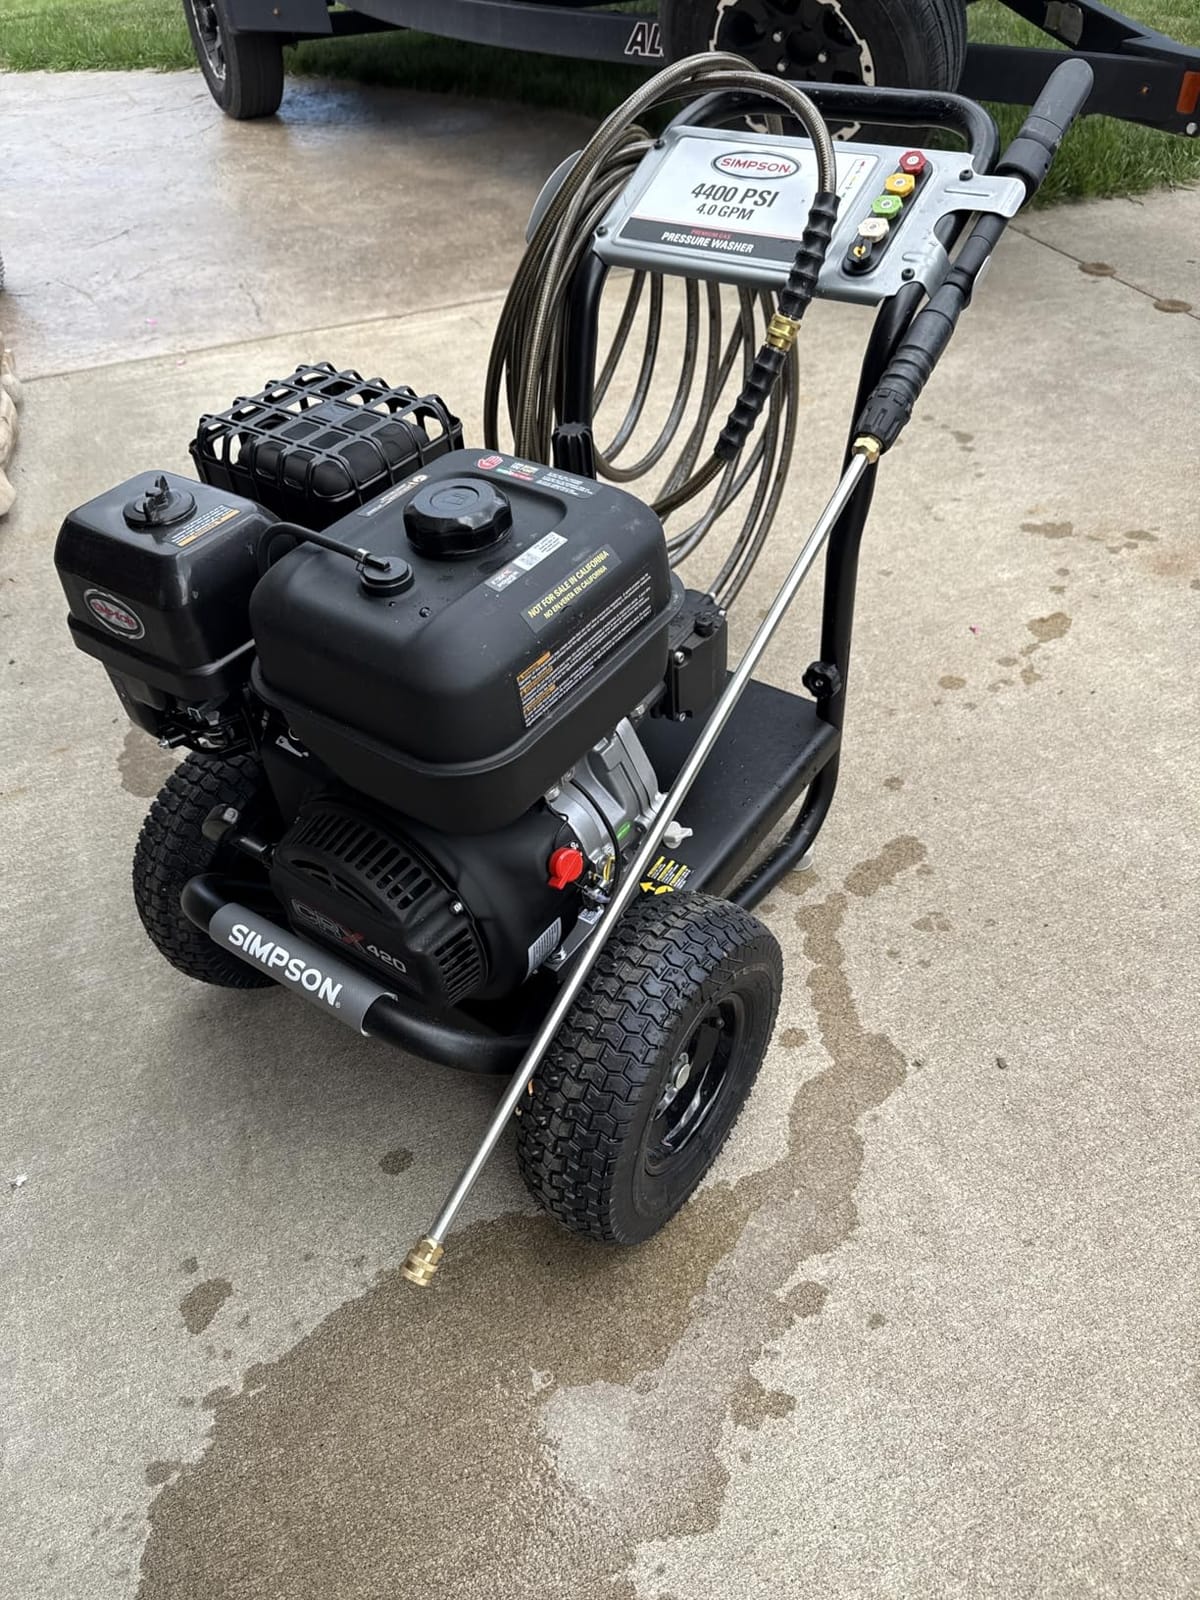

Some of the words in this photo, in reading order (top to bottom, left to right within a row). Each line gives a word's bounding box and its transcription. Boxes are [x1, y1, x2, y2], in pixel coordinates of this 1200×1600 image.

[720, 157, 790, 173] SIMPSON
[691, 183, 738, 203] 4400
[738, 188, 780, 207] PSI
[696, 203, 716, 216] 4.0
[717, 205, 755, 221] GPM
[661, 231, 711, 247] PRESSURE
[711, 239, 754, 253] WASHER
[527, 602, 544, 619] NOT
[541, 593, 555, 607] FOR
[553, 581, 571, 597] SALE
[575, 550, 609, 578] CALIFORNIA
[228, 923, 343, 1007] SIMPSON
[366, 945, 407, 973] 420
